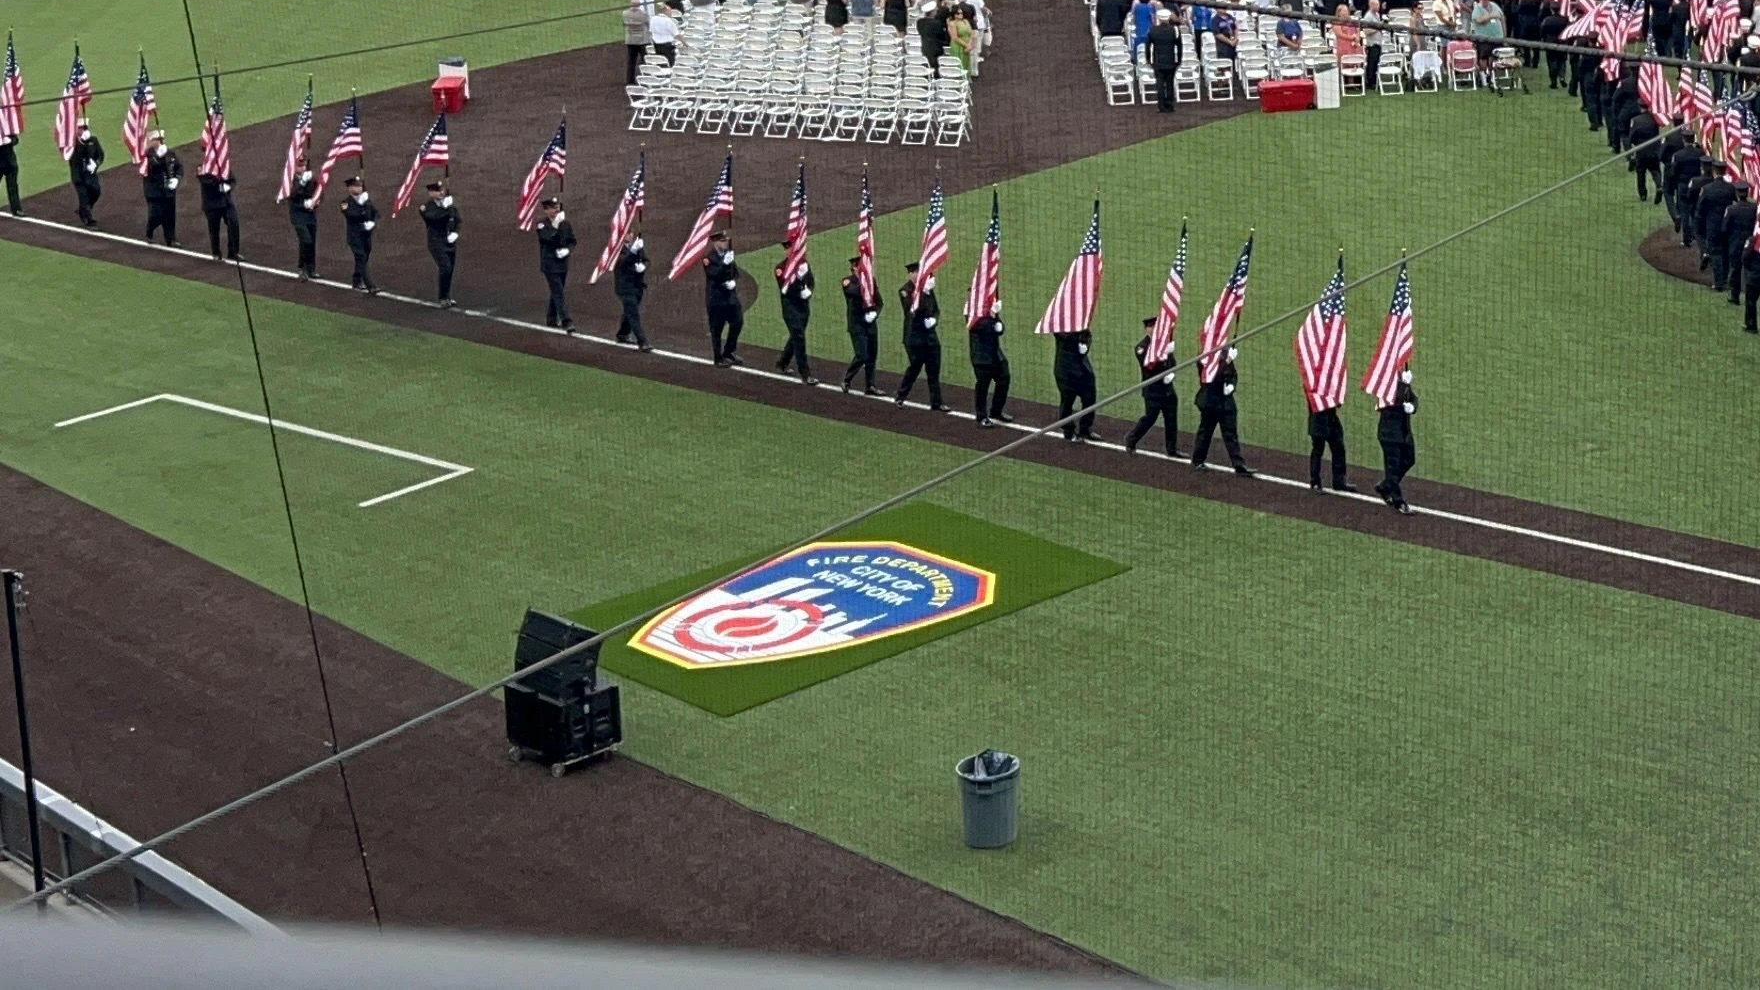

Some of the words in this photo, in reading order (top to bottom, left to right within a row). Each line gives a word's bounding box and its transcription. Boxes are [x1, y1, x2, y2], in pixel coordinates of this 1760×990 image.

[806, 555, 868, 567] FIRE
[871, 556, 954, 608] DEPARTMENT
[812, 570, 864, 589] NEW
[856, 583, 912, 606] YORK
[851, 566, 899, 583] CITY
[891, 579, 925, 591] OF
